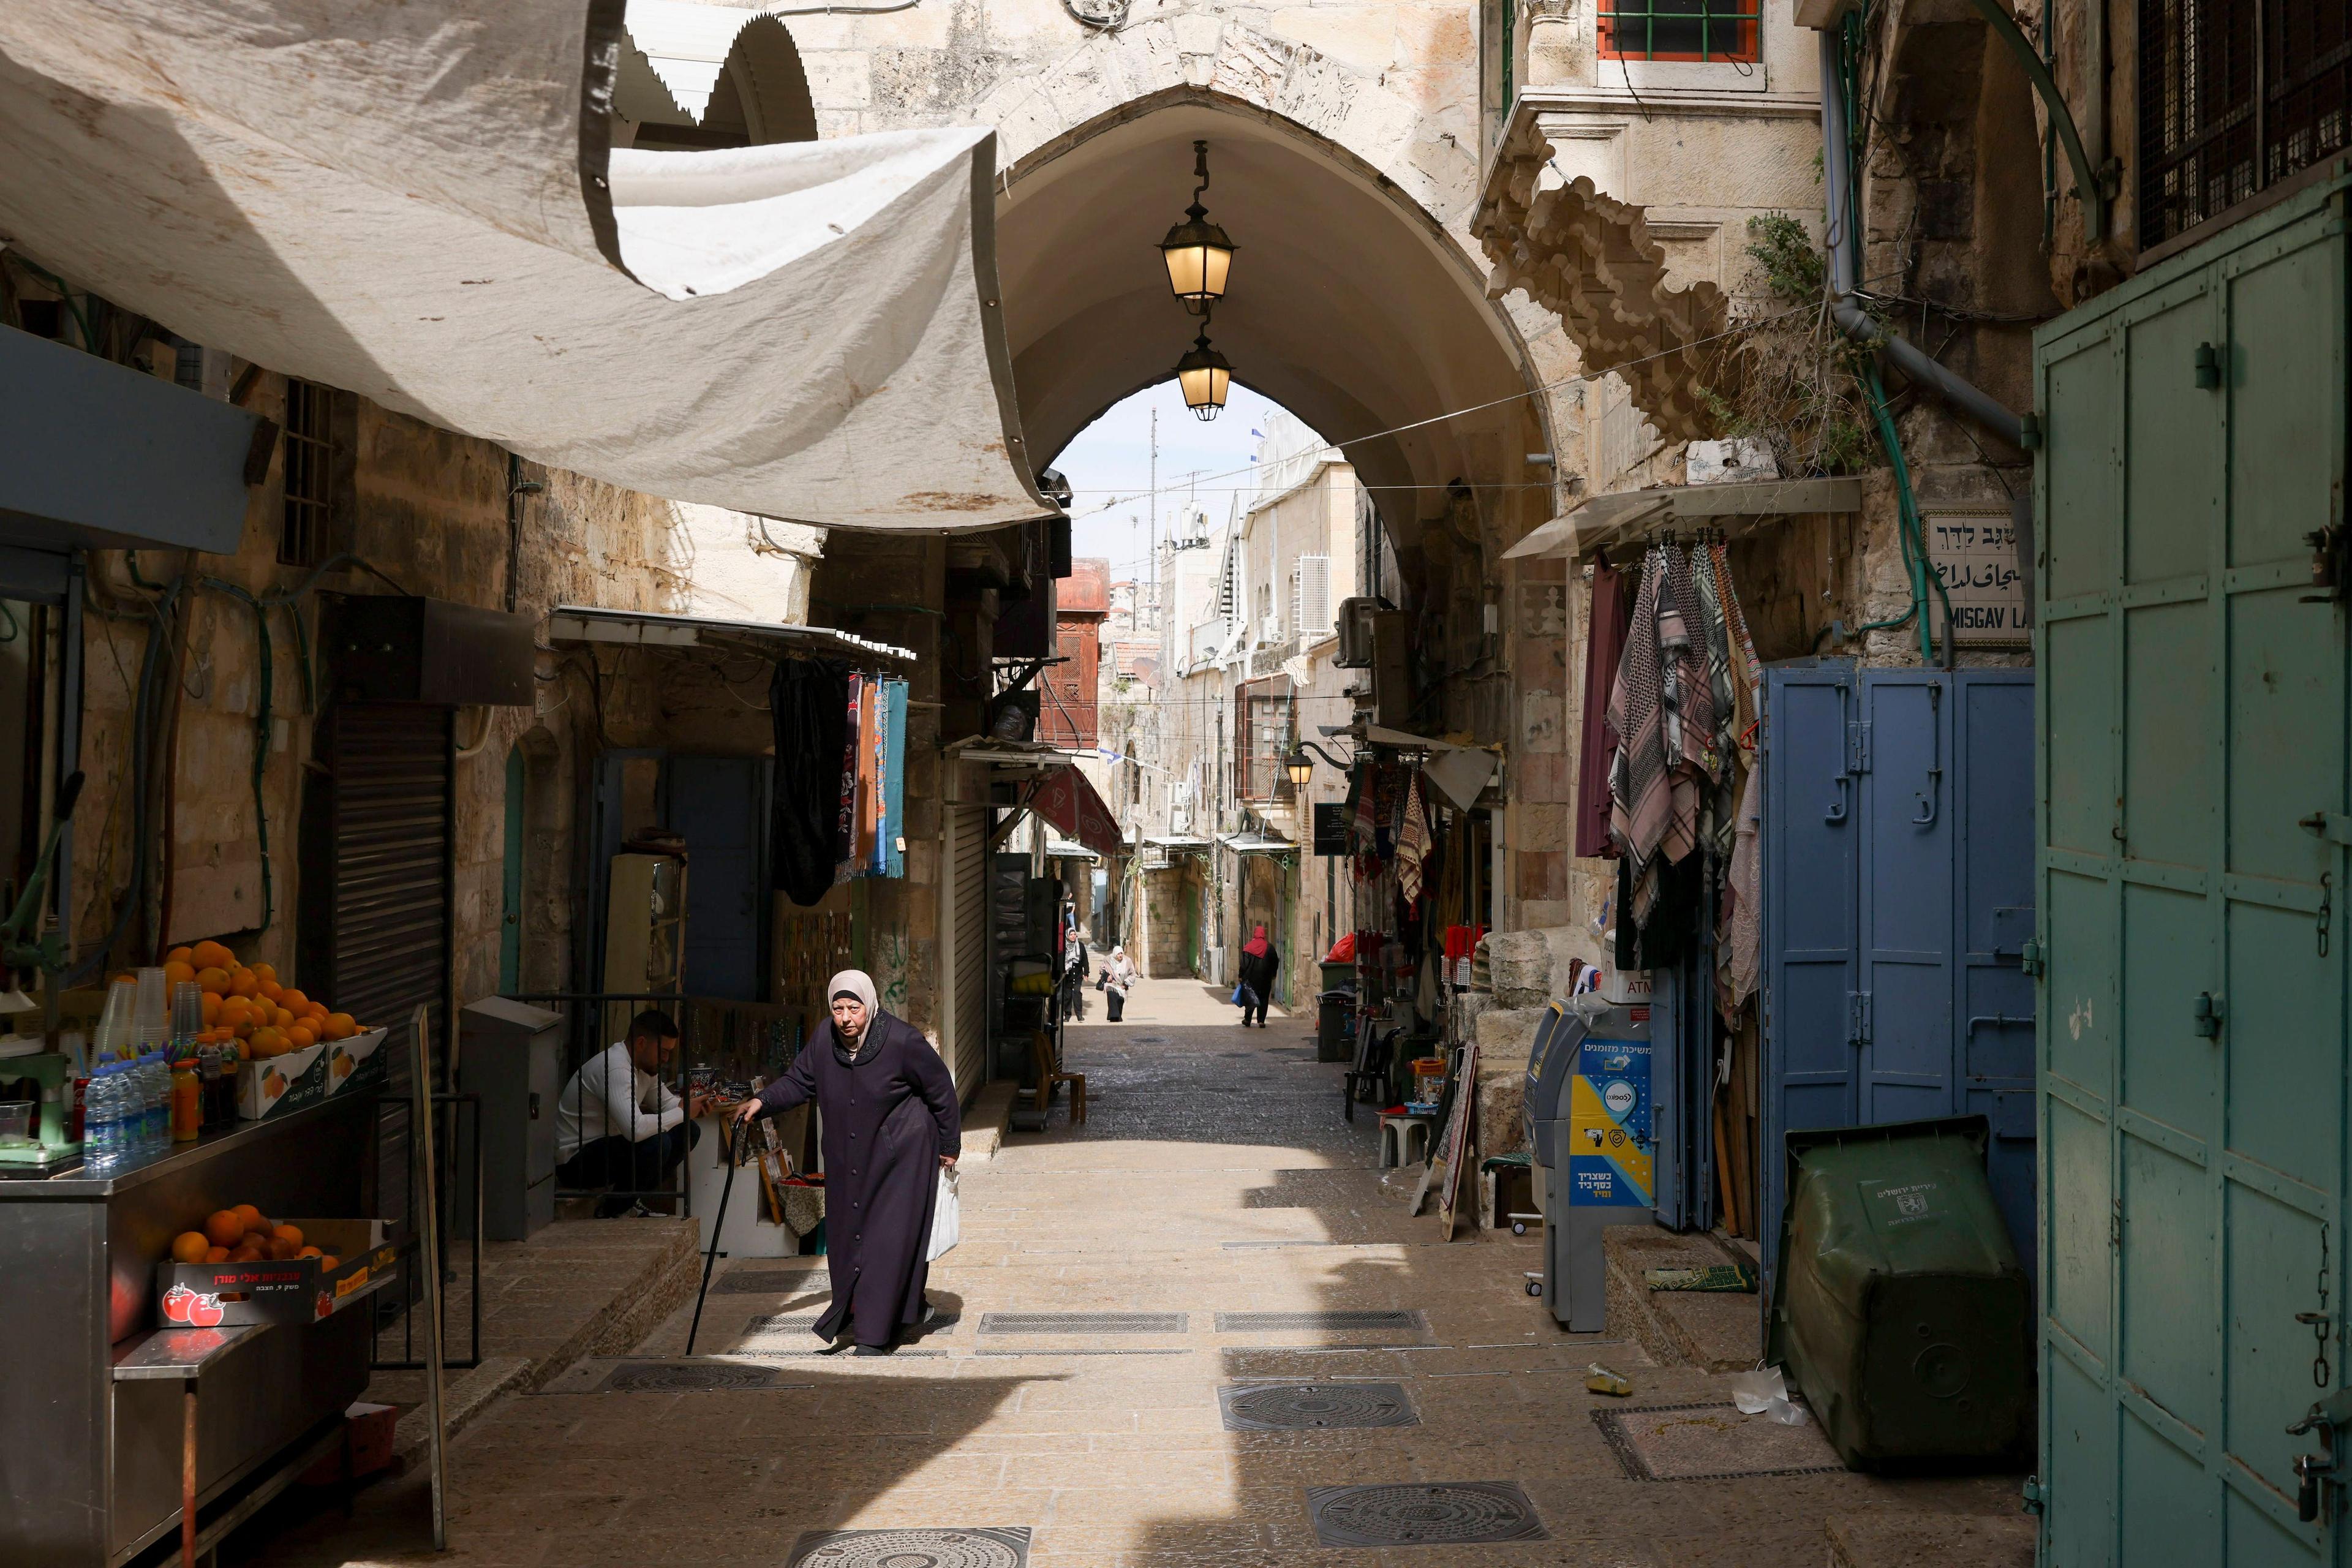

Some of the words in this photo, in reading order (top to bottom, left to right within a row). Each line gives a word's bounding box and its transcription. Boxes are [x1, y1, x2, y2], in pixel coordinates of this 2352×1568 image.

[1950, 607, 2005, 628] MISGAV
[1585, 1044, 1619, 1053] מזומנים
[1621, 1046, 1651, 1055] משיכת
[1593, 1182, 1612, 1190] כסף
[1876, 1186, 1909, 1199] ירושלים
[213, 1274, 237, 1286] מורן
[239, 1272, 260, 1283] אלי
